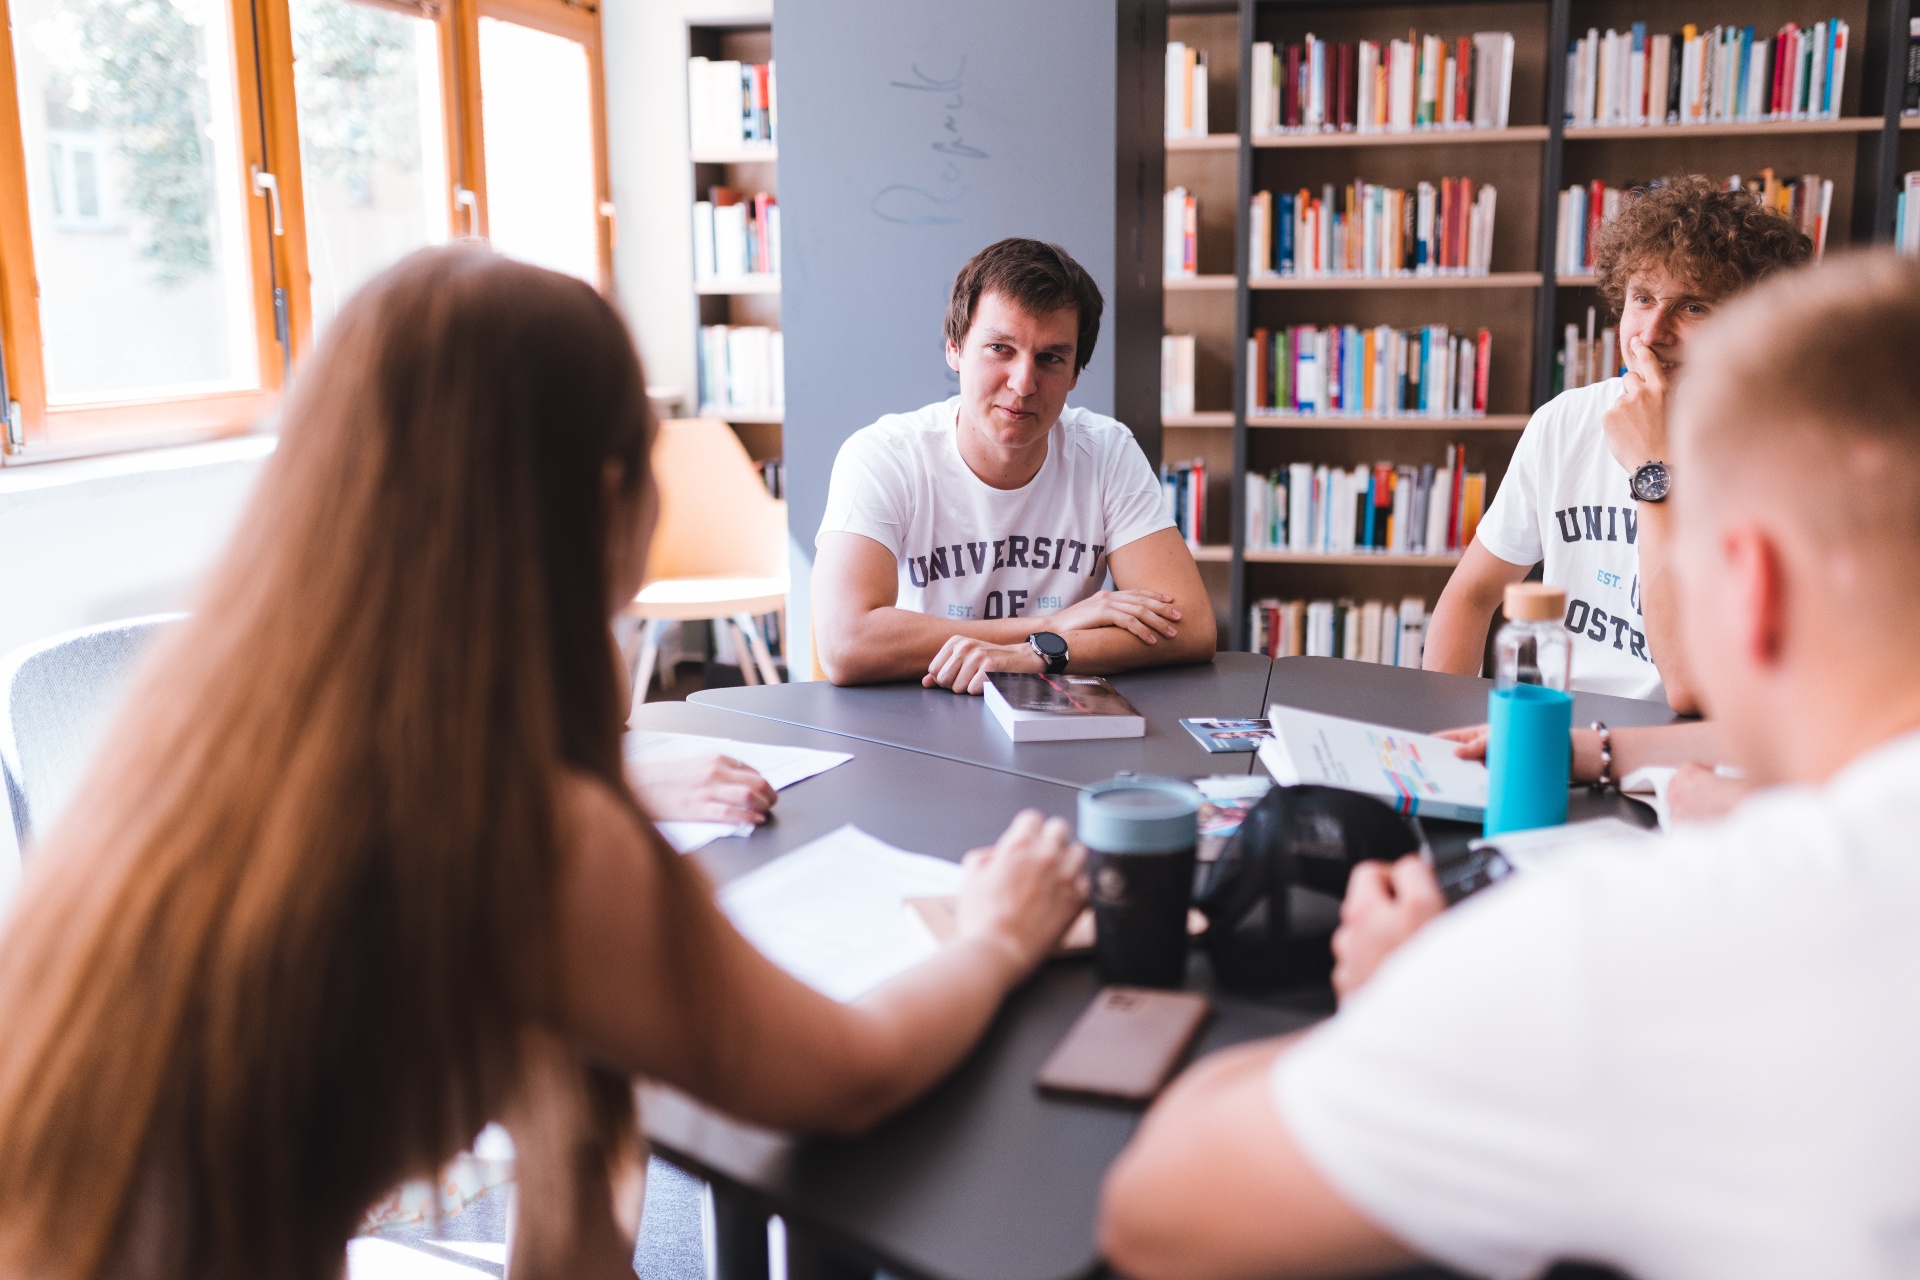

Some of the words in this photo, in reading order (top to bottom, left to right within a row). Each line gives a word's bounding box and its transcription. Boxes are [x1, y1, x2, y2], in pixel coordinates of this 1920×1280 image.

[907, 535, 1105, 588] UNIVERSITY
[1597, 569, 1622, 590] EST.
[947, 603, 976, 618] EST.
[983, 589, 1028, 620] OF
[1037, 596, 1063, 609] 1991
[1564, 598, 1655, 664] OSTR
